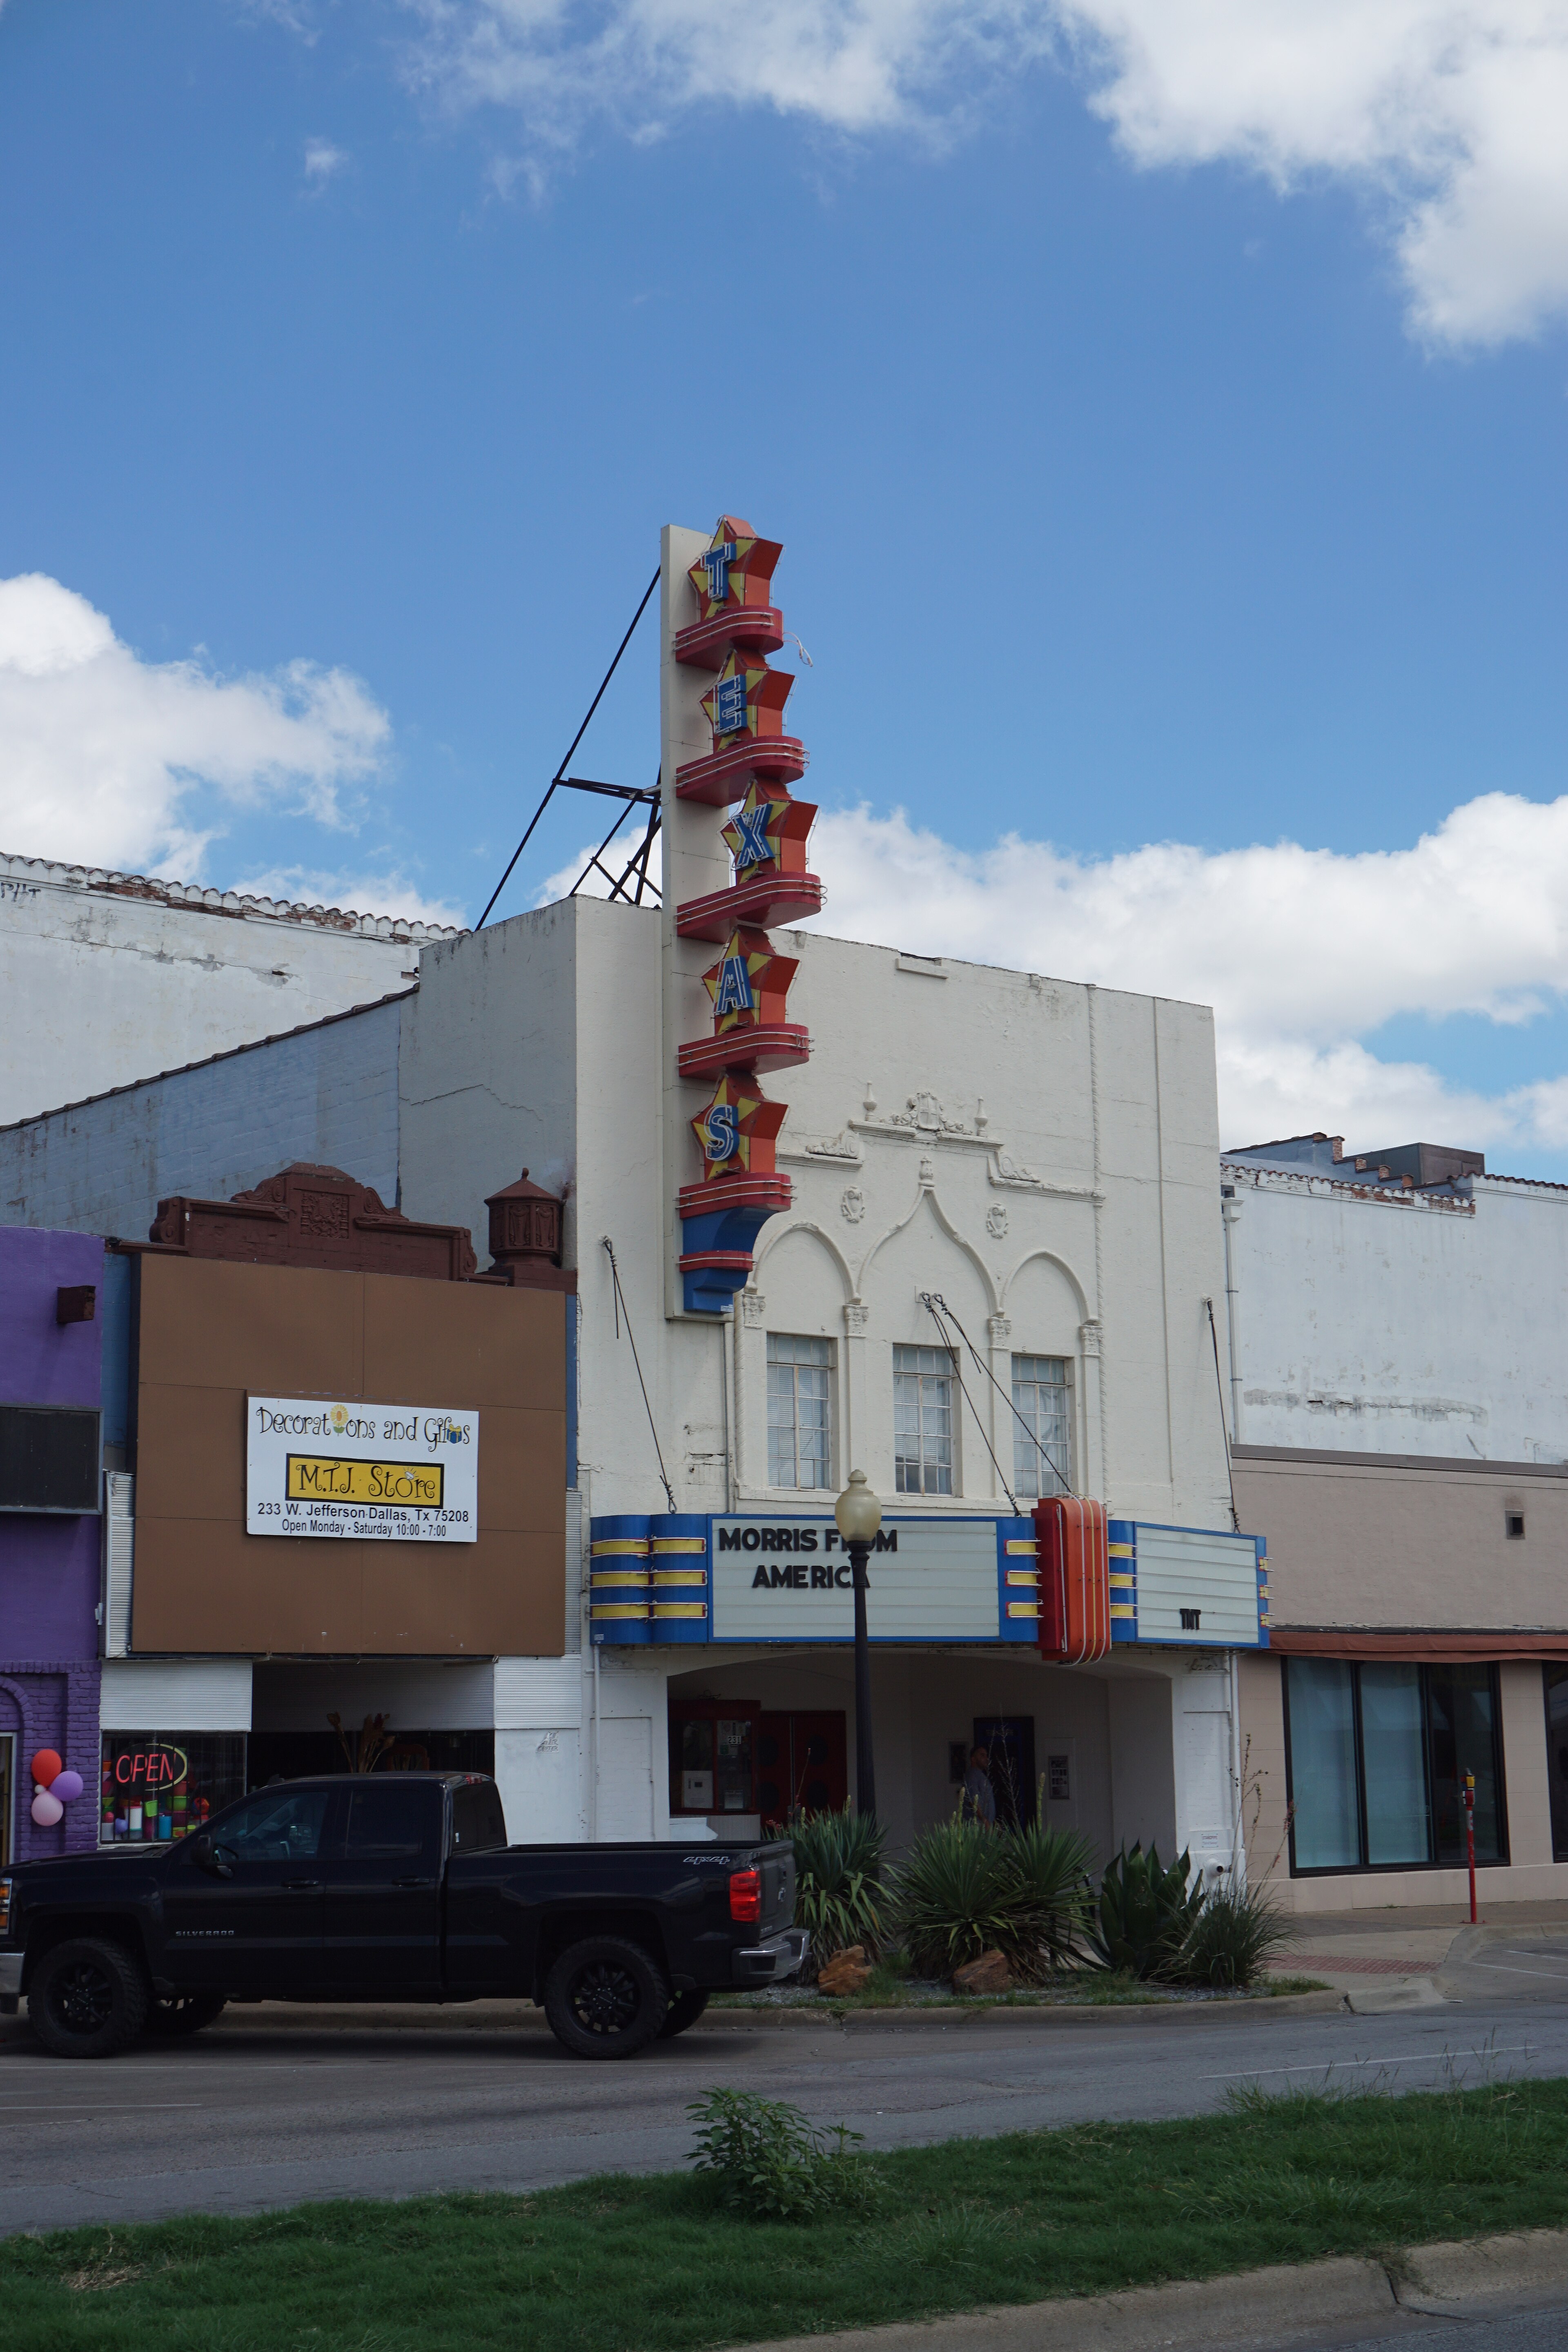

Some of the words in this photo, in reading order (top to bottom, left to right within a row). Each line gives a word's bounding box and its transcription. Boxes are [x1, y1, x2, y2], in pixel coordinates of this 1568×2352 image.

[256, 1405, 375, 1439] Decoratons
[383, 1417, 419, 1441] and
[424, 1417, 470, 1452] Gifs
[369, 1465, 435, 1499] Store
[258, 1502, 281, 1515] 233
[286, 1503, 302, 1516] W.
[306, 1503, 365, 1518] Jefferson
[369, 1507, 410, 1523] Dallas,
[415, 1509, 430, 1521] Tx
[434, 1510, 469, 1522] 75208
[282, 1519, 307, 1534] Open
[310, 1520, 345, 1536] Monday
[354, 1521, 393, 1538] Saturday
[396, 1523, 420, 1536] 10:00
[428, 1524, 446, 1537] 7:00
[719, 1528, 818, 1551] MORRIS
[825, 1529, 898, 1552] FM
[728, 1736, 741, 1744] 231
[116, 1753, 176, 1783] OPEN
